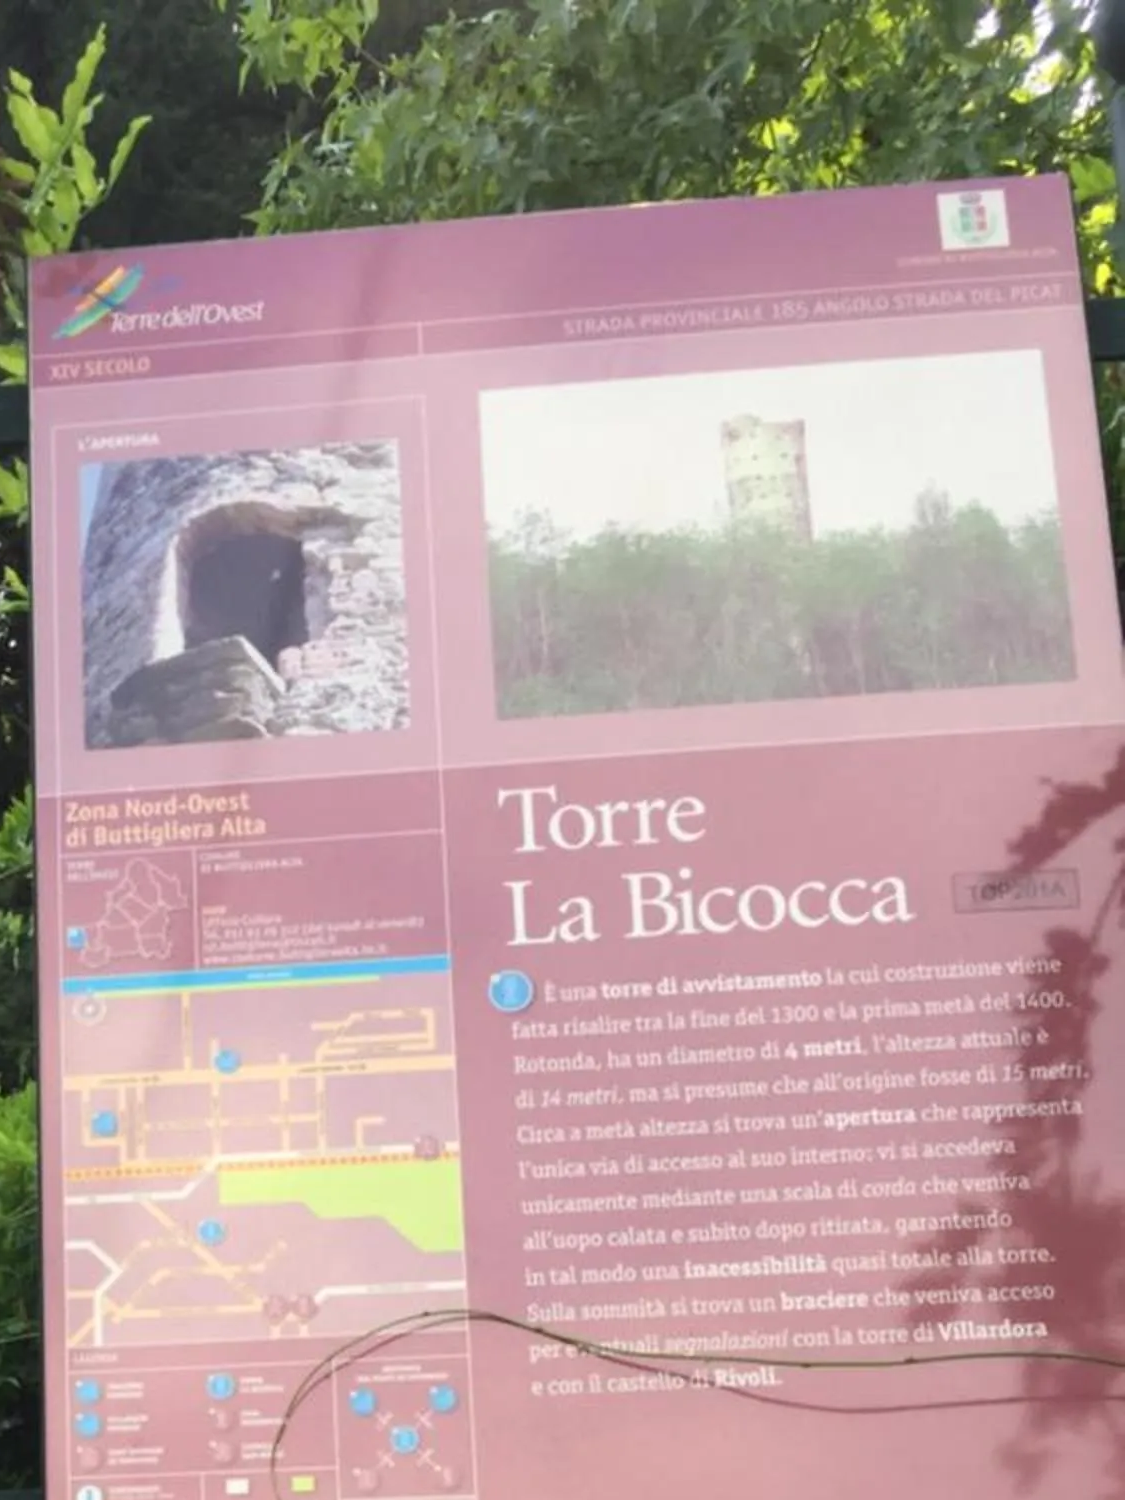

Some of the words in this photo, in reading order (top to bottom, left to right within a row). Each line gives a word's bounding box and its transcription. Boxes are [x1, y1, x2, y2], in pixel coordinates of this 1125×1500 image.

[109, 310, 162, 335] Terre
[163, 301, 265, 325] dell'Ovest
[563, 316, 636, 336] STRADA
[640, 305, 766, 331] PROVINCIALE
[772, 302, 809, 323] 185
[812, 296, 890, 318] ANGOLO
[890, 289, 965, 312] STRADA
[969, 286, 1006, 307] DEL
[49, 363, 81, 381] XIV
[84, 357, 151, 378] SECOLO
[77, 434, 160, 452] L'APERTURA
[65, 801, 119, 824] Zona
[125, 791, 250, 818] Nord-Ovest
[498, 784, 707, 854] Torre
[66, 826, 88, 848] di
[95, 819, 215, 847] Buttigliera
[220, 814, 267, 837] Alta
[503, 879, 601, 946] La
[621, 867, 916, 939] Bicocca
[560, 986, 597, 1001] una
[601, 980, 652, 999] torre
[657, 977, 677, 996] di
[683, 970, 822, 994] avvistamento
[826, 967, 843, 985] la
[848, 964, 880, 984] cui
[885, 959, 1002, 983] costruzione
[1004, 957, 1062, 975] viene
[512, 1020, 557, 1041] fatta
[563, 1016, 632, 1036] risalire
[635, 1015, 663, 1031] tra
[668, 1012, 685, 1029] la
[691, 1009, 730, 1028] fine
[735, 1007, 766, 1026] del
[771, 1004, 818, 1024] 1300
[823, 1008, 835, 1021] e
[839, 1001, 857, 1020] la
[863, 998, 921, 1022] prima
[925, 993, 976, 1014] metà
[979, 992, 1011, 1011] del
[1018, 991, 1072, 1009] 1400.
[514, 1052, 601, 1075] Rotonda,
[607, 1050, 631, 1069] ha
[637, 1051, 662, 1067] un
[667, 1044, 754, 1065] diametro
[761, 1041, 780, 1060] di
[784, 1043, 798, 1061] 4
[873, 1031, 956, 1053] l'altezza
[961, 1027, 1032, 1049] attuale
[1037, 1028, 1049, 1045] è
[515, 1090, 535, 1109] di
[542, 1089, 561, 1107] 14
[629, 1086, 658, 1103] ma
[664, 1081, 680, 1100] si
[685, 1080, 768, 1103] presume
[772, 1075, 809, 1094] che
[813, 1071, 916, 1095] all'origine
[920, 1067, 971, 1089] fosse
[977, 1065, 996, 1084] di
[1002, 1064, 1024, 1083] 15
[517, 1123, 565, 1145] Circa
[570, 1127, 581, 1142] a
[586, 1119, 635, 1140] metà
[639, 1116, 709, 1136] altezza
[714, 1114, 729, 1134] si
[734, 1113, 786, 1133] trova
[791, 1104, 917, 1131] un'apertura
[921, 1103, 958, 1122] che
[962, 1097, 1083, 1124] rappresenta
[519, 1158, 585, 1180] l'unica
[590, 1157, 619, 1176] via
[625, 1154, 644, 1174] di
[648, 1152, 724, 1172] accesso
[728, 1148, 746, 1168] al
[750, 1147, 786, 1168] suo
[877, 1141, 895, 1160] vi
[901, 1139, 917, 1159] si
[922, 1136, 1017, 1158] accedeva
[522, 1192, 638, 1215] unicamente
[643, 1187, 735, 1209] mediante
[741, 1185, 778, 1202] una
[783, 1180, 832, 1201] scala
[838, 1179, 857, 1198] di
[862, 1176, 916, 1197] corda
[921, 1175, 959, 1194] che
[961, 1174, 1030, 1192] veniva
[523, 1232, 603, 1252] all'uopo
[608, 1227, 666, 1247] calata
[672, 1227, 684, 1244] e
[689, 1221, 751, 1242] subito
[755, 1219, 806, 1243] dopo
[896, 1208, 1012, 1236] garantendo
[525, 1268, 545, 1286] in
[550, 1266, 576, 1285] tal
[581, 1264, 637, 1284] modo
[643, 1264, 680, 1280] una
[831, 1252, 886, 1275] quasi
[892, 1249, 953, 1269] totale
[957, 1246, 993, 1266] alla
[997, 1245, 1056, 1264] torre.
[527, 1302, 575, 1323] Sulla
[581, 1297, 665, 1320] sommità
[671, 1296, 688, 1316] si
[692, 1295, 744, 1314] trova
[750, 1295, 776, 1312] un
[780, 1287, 868, 1311] braciere
[873, 1284, 910, 1307] che
[914, 1284, 983, 1304] veniva
[988, 1284, 1055, 1300] acceso
[529, 1342, 561, 1364] per
[792, 1328, 832, 1347] con
[834, 1328, 852, 1345] la
[857, 1324, 909, 1344] torre
[913, 1321, 934, 1342] di
[938, 1318, 1048, 1342] Villardora
[530, 1379, 544, 1395] e
[548, 1379, 584, 1395] con
[588, 1374, 602, 1393] il
[607, 1370, 686, 1393] castello
[689, 1369, 710, 1389] di
